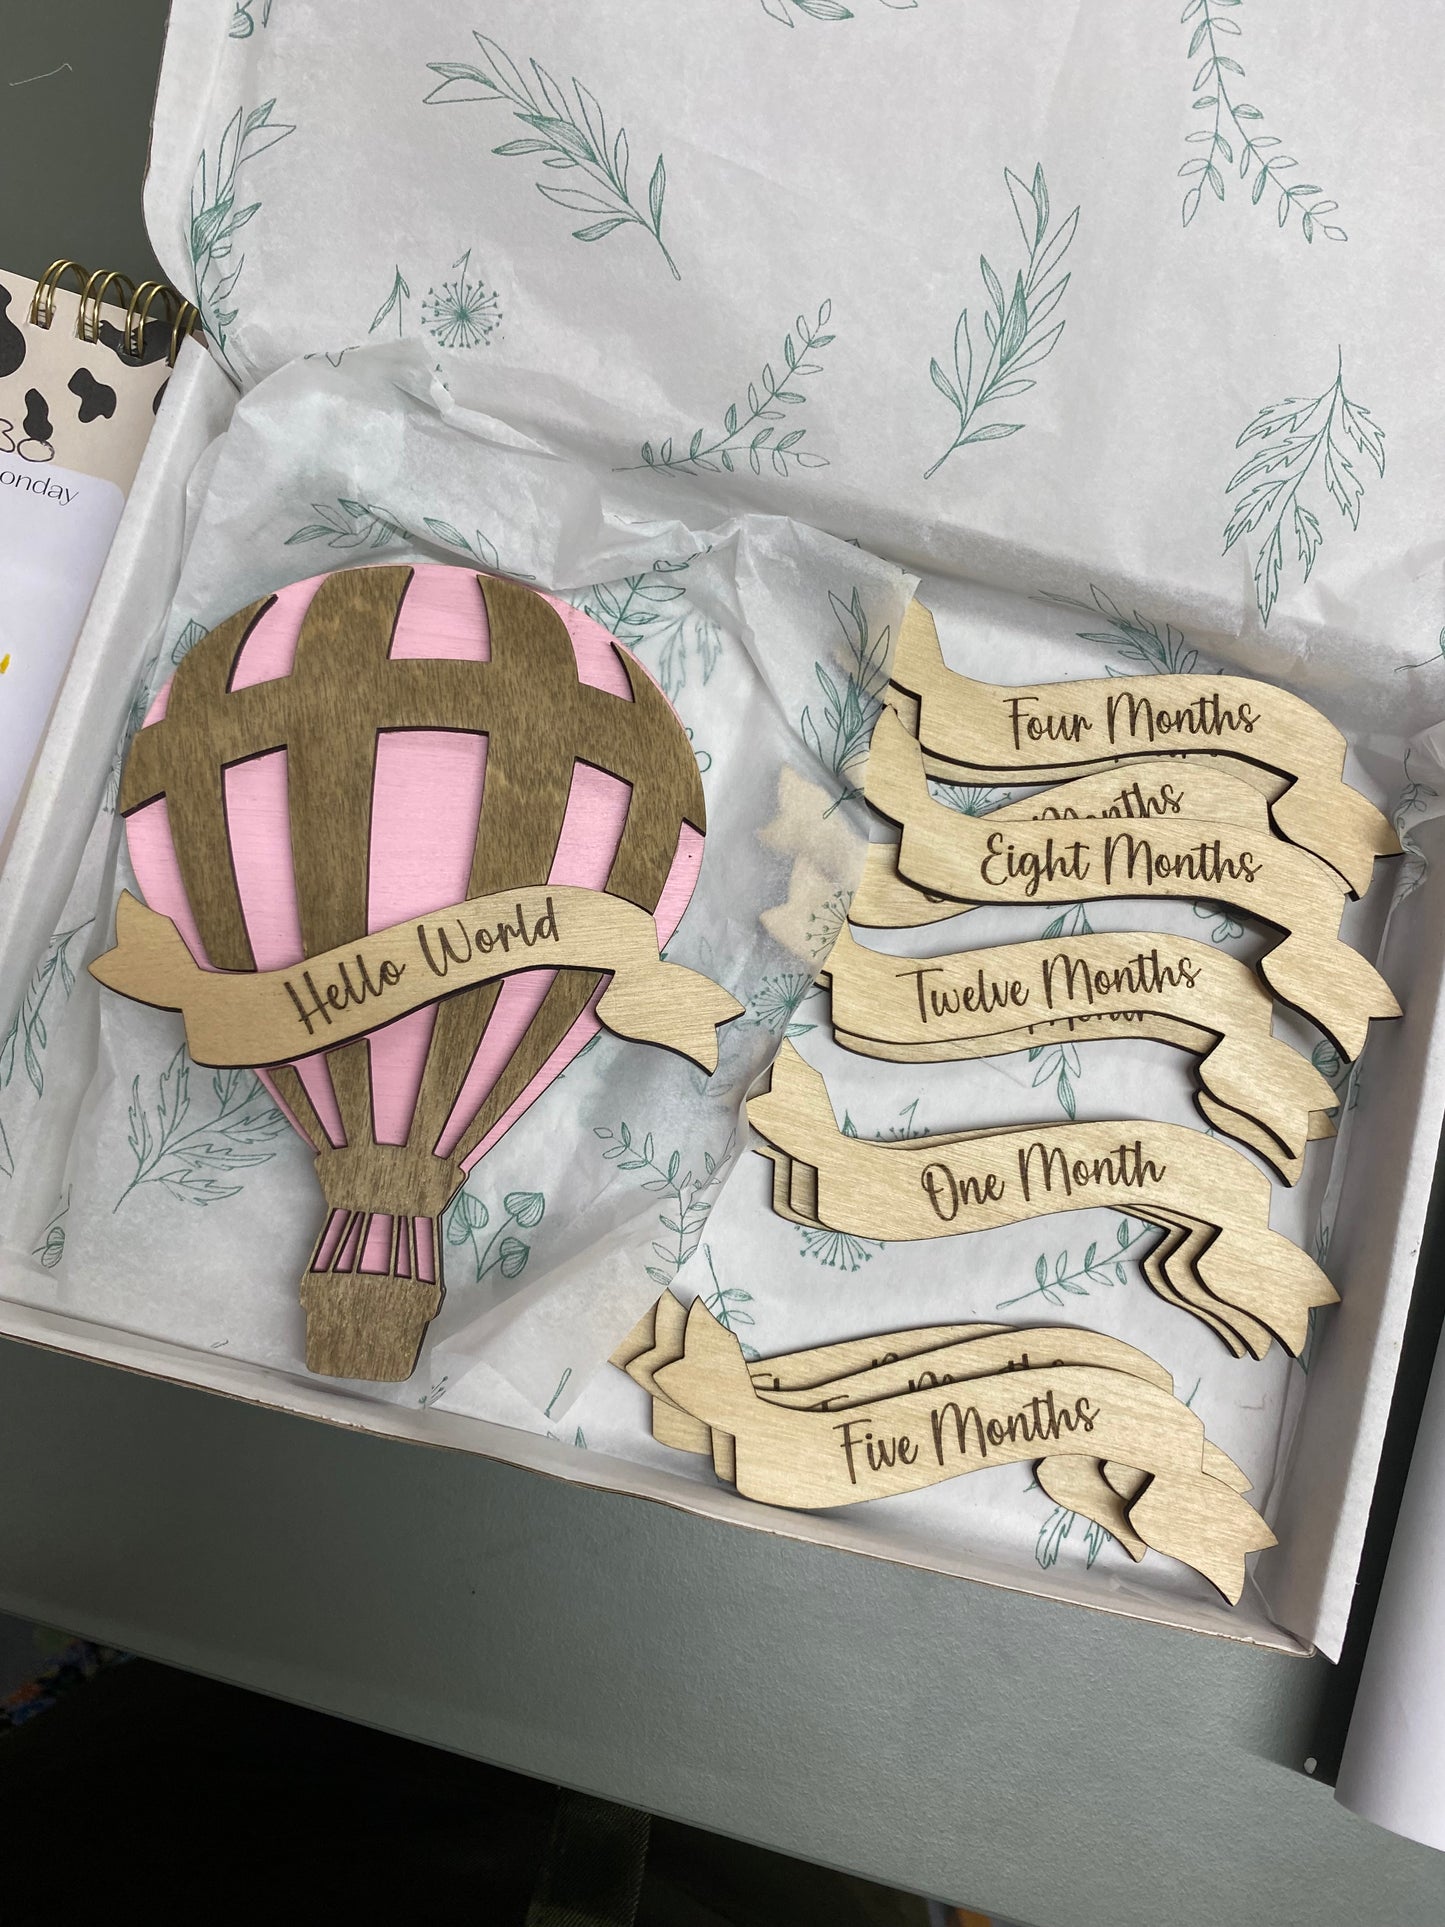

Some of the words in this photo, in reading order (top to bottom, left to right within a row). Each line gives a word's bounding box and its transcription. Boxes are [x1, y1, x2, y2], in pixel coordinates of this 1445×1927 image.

[0, 471, 79, 506] onday
[1003, 696, 1093, 750] Four
[1107, 691, 1261, 744] Months
[981, 832, 1090, 897] Eight
[1104, 832, 1262, 886] Months
[284, 954, 406, 1035] Hello
[417, 896, 560, 977] World
[895, 968, 1029, 1023] Twelve
[1042, 949, 1202, 1010] Months
[921, 1163, 1005, 1222] One
[1018, 1140, 1166, 1202] Month
[833, 1418, 918, 1485] Five
[931, 1390, 1101, 1466] Months
